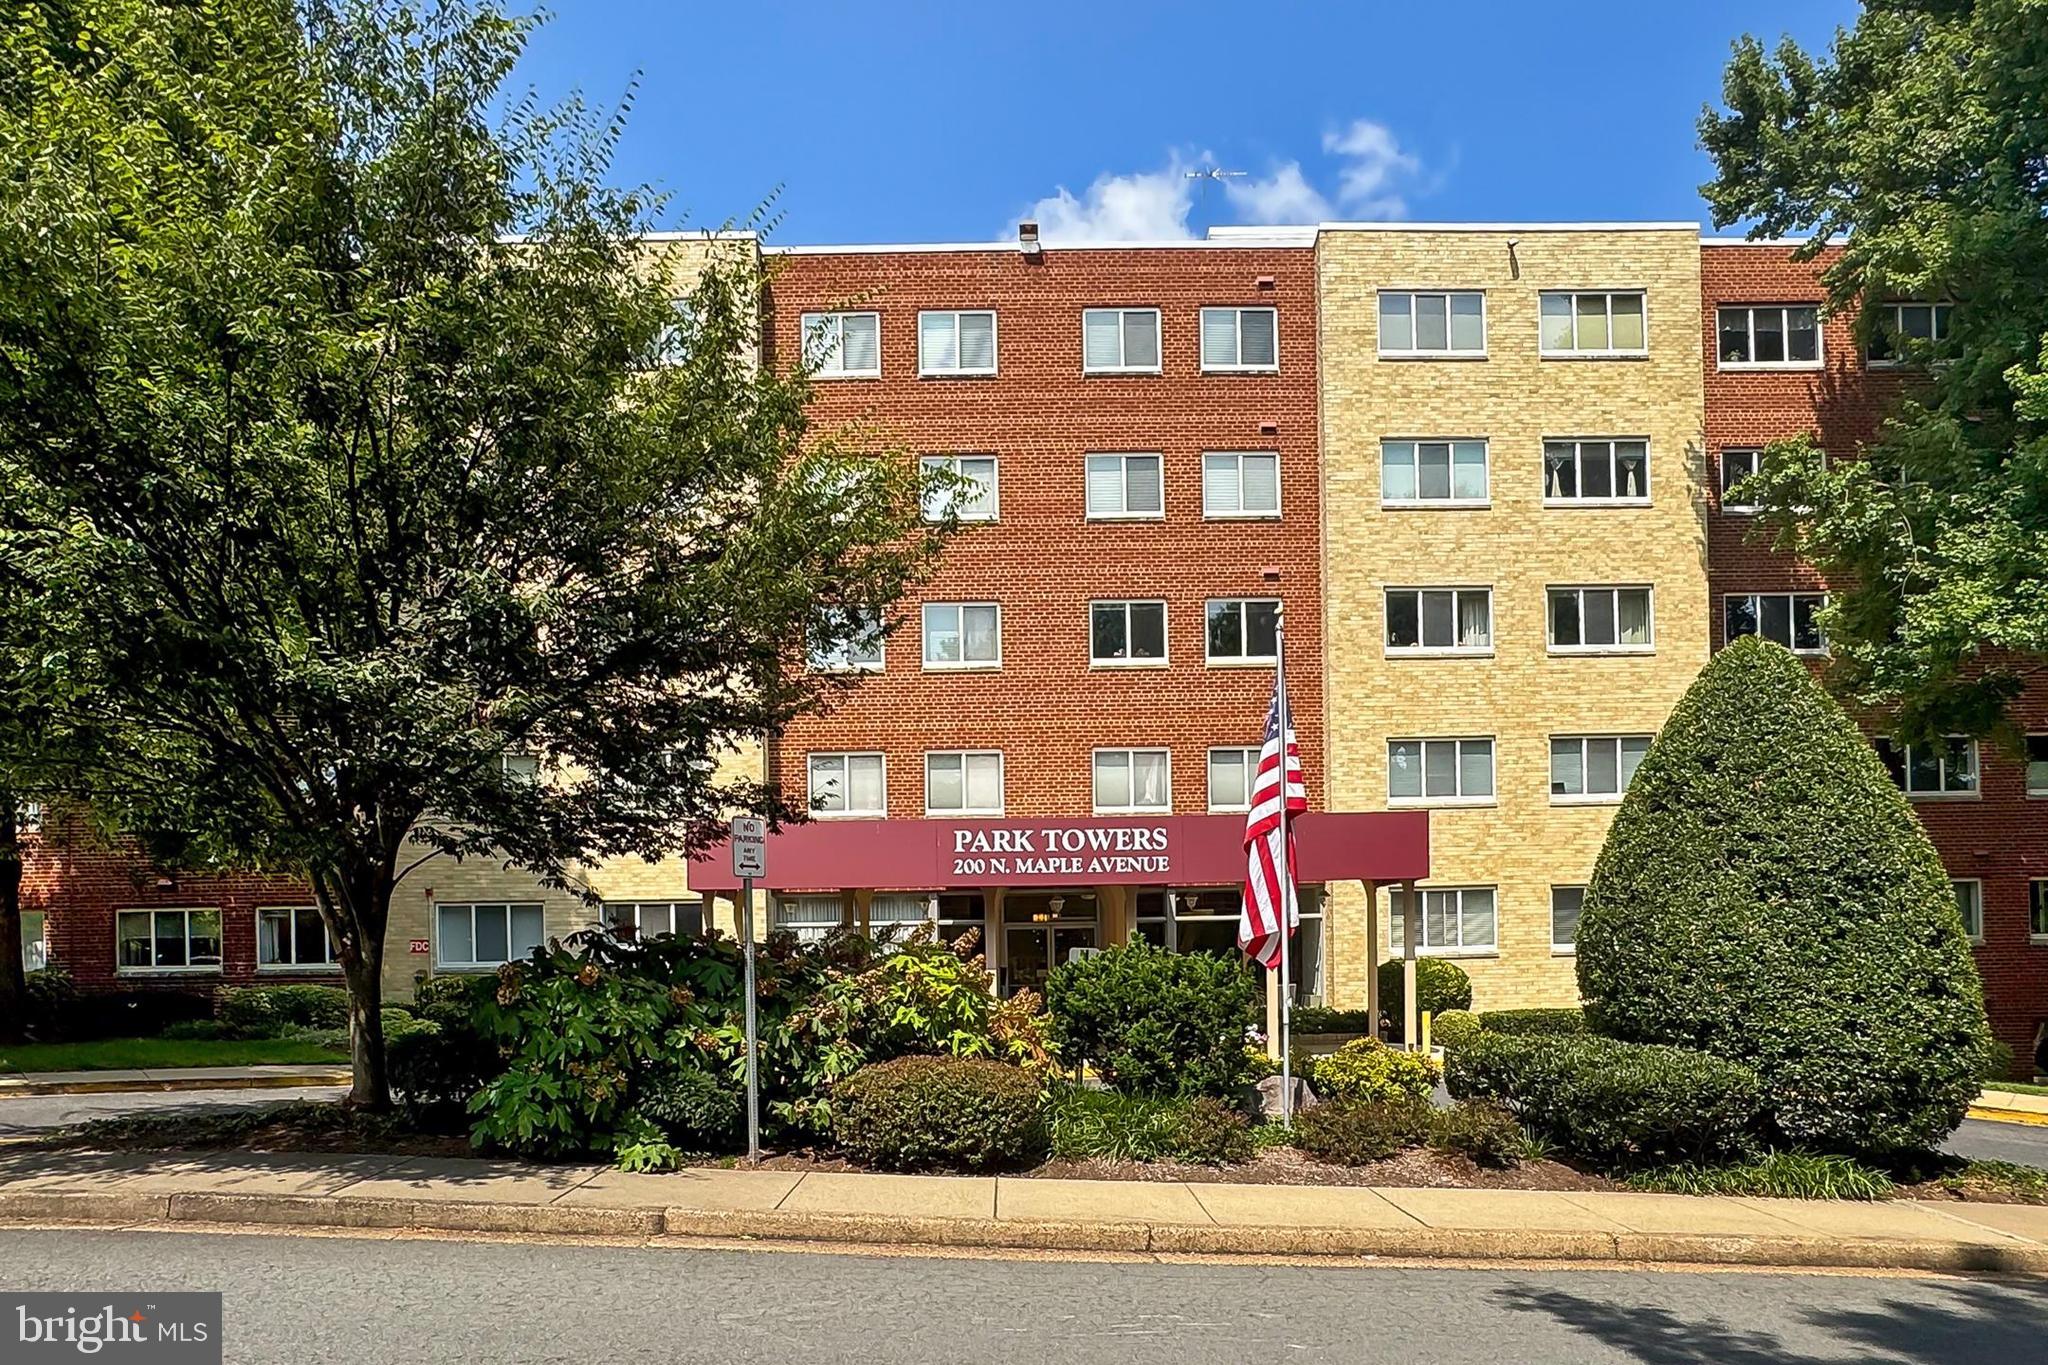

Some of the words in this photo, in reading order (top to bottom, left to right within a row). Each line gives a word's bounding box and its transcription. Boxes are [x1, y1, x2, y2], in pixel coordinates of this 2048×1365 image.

[743, 822, 755, 832] NO
[735, 835, 765, 844] PARKING
[954, 830, 1034, 852] PARK
[1041, 828, 1168, 851] TOWERS
[953, 859, 985, 874] 200
[990, 858, 1010, 873] N.
[1016, 857, 1083, 874] MAPLE
[1087, 856, 1169, 873] AVENUE
[410, 941, 429, 951] FDC
